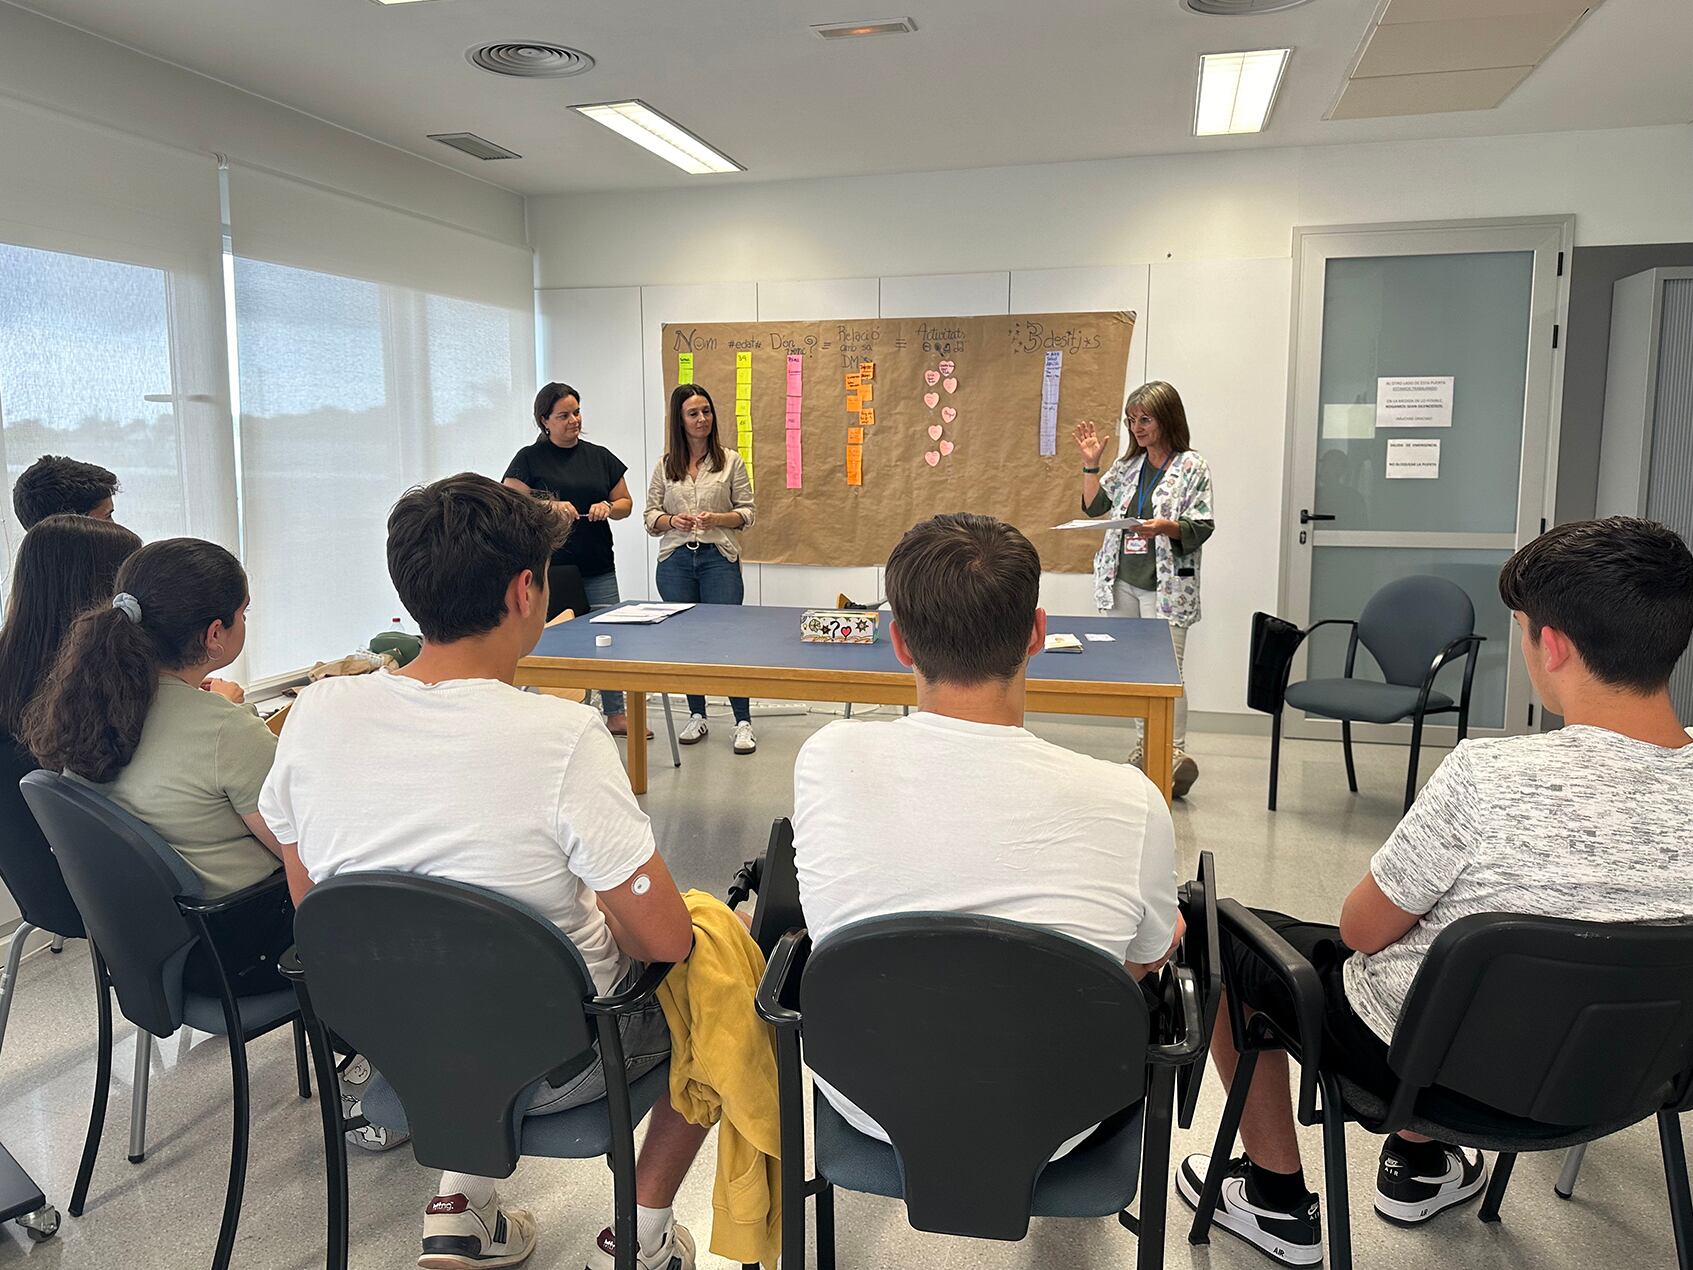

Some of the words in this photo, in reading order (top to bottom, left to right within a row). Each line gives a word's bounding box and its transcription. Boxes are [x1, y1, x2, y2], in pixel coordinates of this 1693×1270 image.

[674, 329, 718, 352] Nom
[1384, 1167, 1399, 1177] AIR
[1273, 1246, 1285, 1258] AIR
